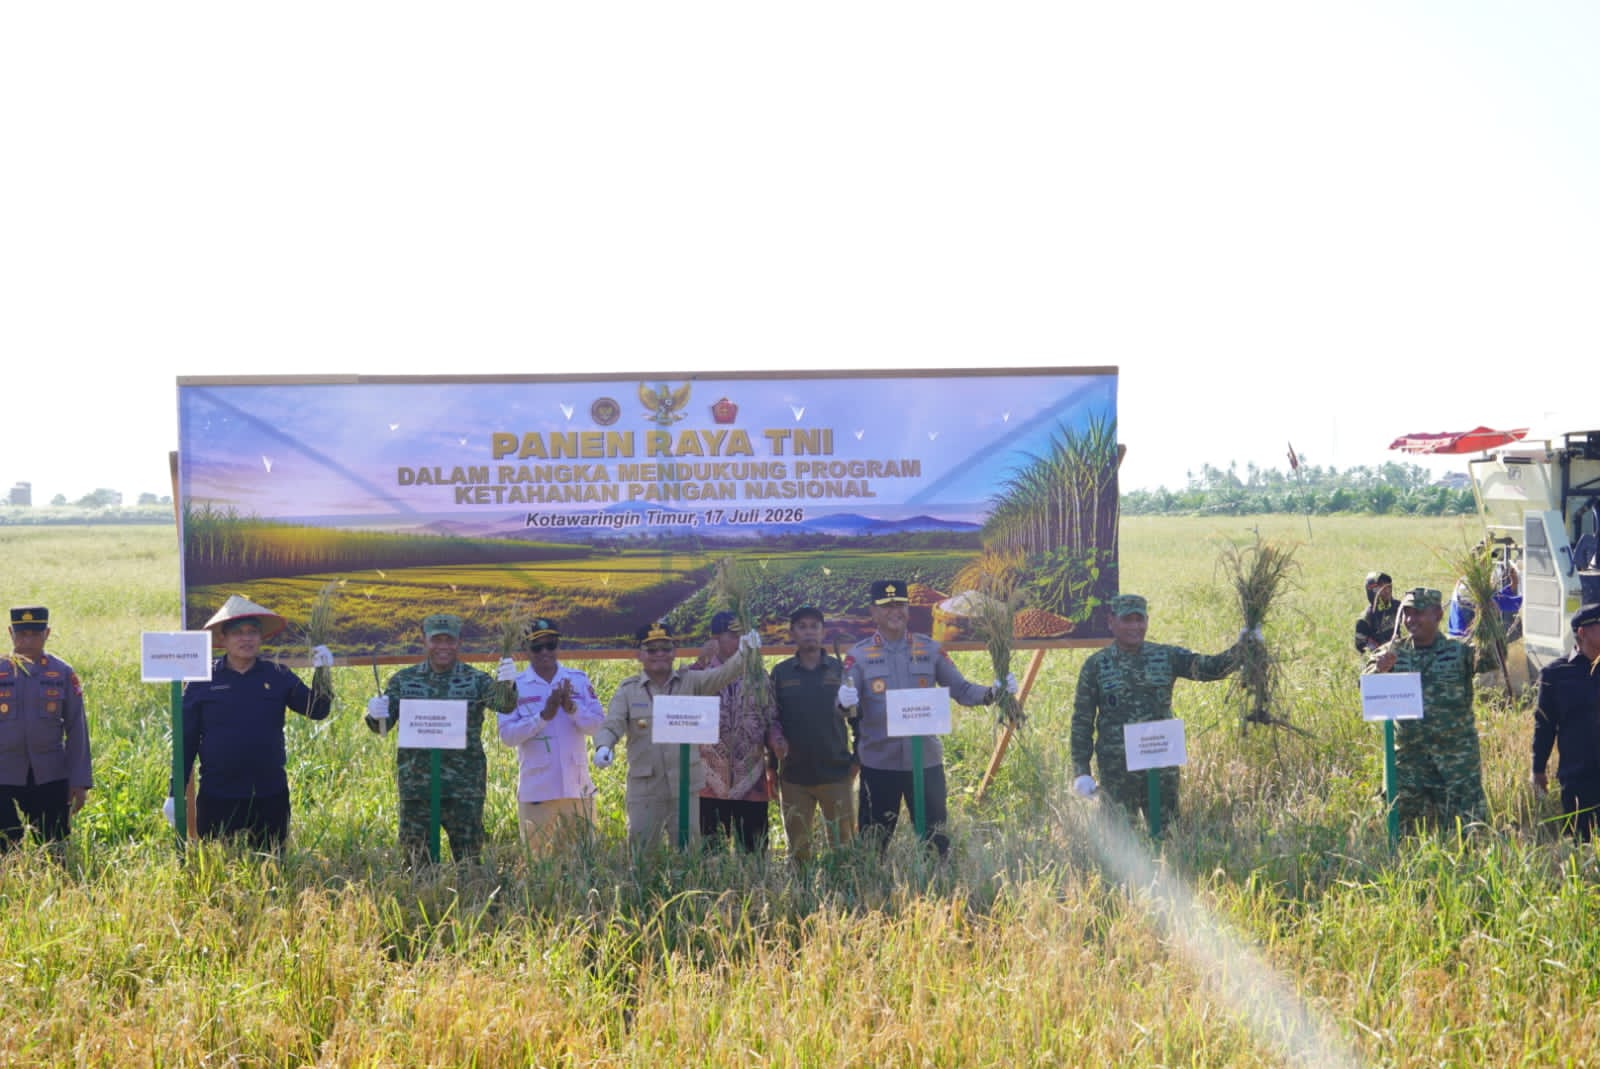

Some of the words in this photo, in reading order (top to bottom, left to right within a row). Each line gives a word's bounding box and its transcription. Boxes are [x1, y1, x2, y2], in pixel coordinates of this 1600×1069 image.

[492, 431, 635, 459] PANEN
[648, 429, 754, 458] RAYA
[764, 427, 834, 456] TNI
[397, 466, 490, 485] DALAM
[497, 464, 611, 484] RANGKA
[618, 461, 788, 482] MENDUKUNG
[794, 459, 922, 479] PROGRAM
[455, 484, 619, 504] KETAHANAN
[628, 482, 737, 502] PANGAN
[745, 479, 876, 500] NASIONAL
[526, 511, 641, 529] Kotawaringin
[647, 510, 699, 526] Timur,
[705, 510, 721, 524] 17
[728, 509, 759, 524] Juli
[765, 508, 803, 523] 2026
